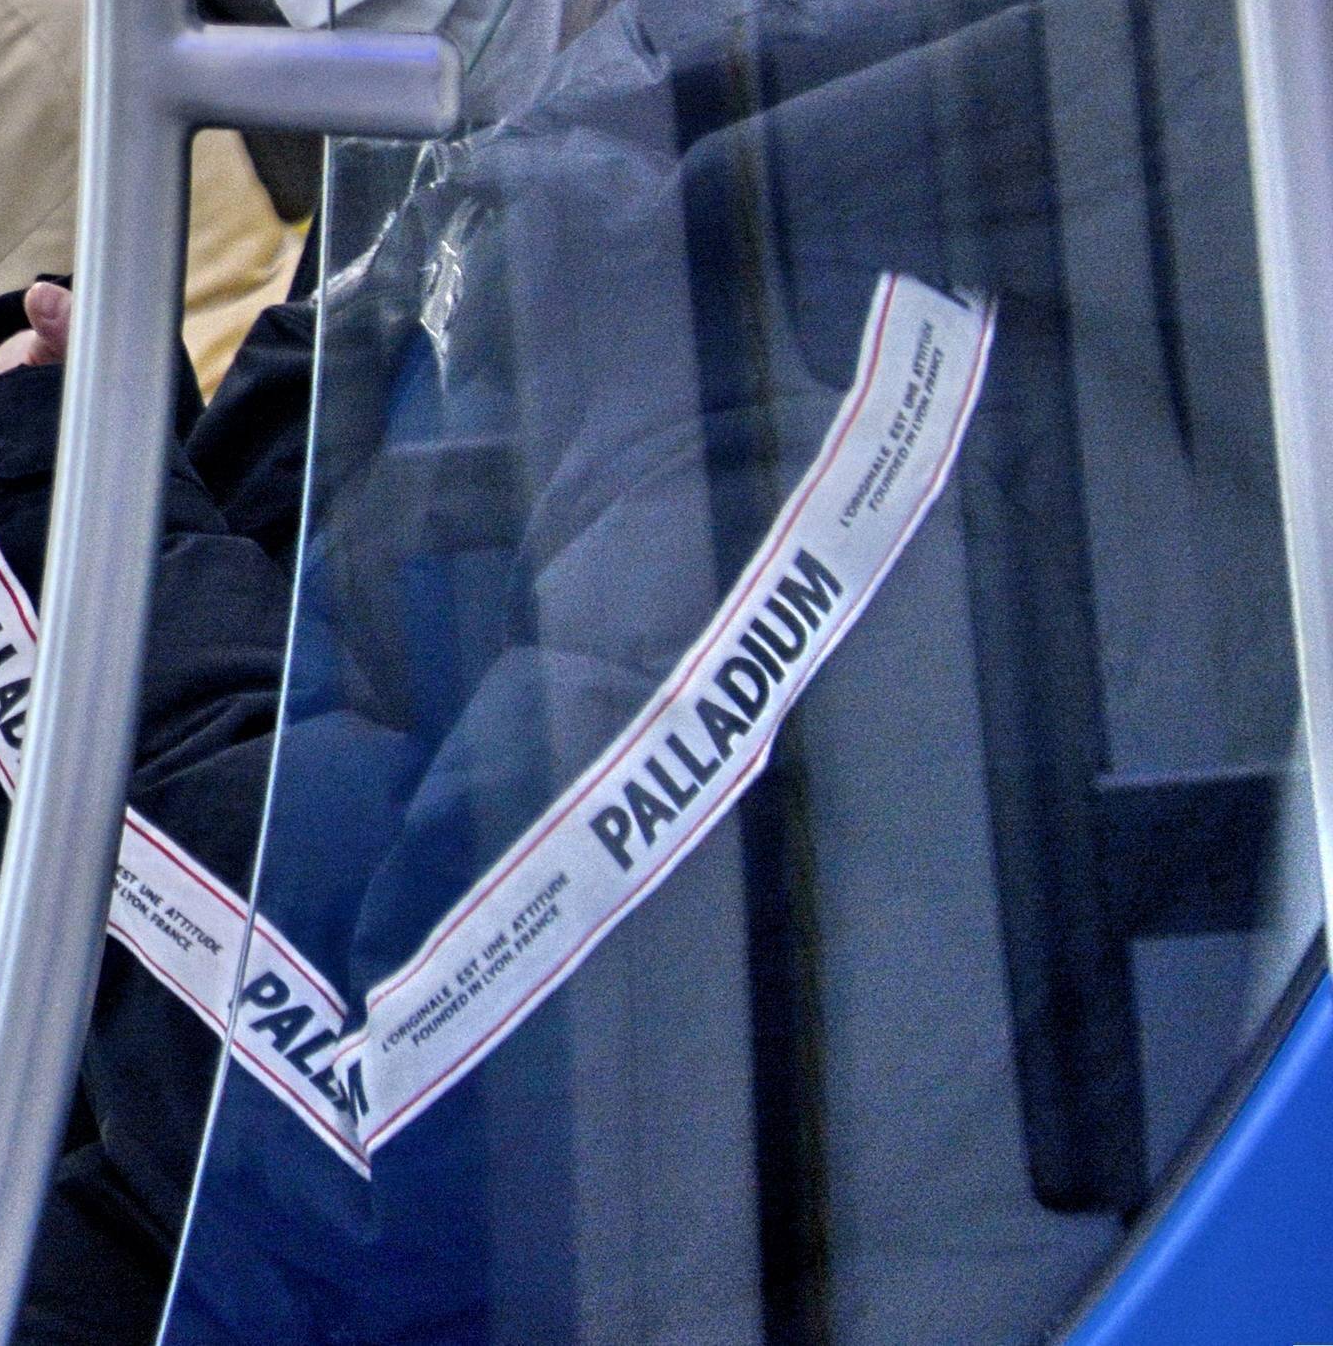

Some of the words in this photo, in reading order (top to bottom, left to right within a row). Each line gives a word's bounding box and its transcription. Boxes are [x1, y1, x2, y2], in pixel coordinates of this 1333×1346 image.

[890, 410, 909, 441] EST
[589, 548, 844, 872] PALLADIUM
[139, 884, 164, 907] UNE
[165, 907, 224, 955] ATTITUDE
[150, 913, 193, 952] FRANCE
[381, 984, 452, 1053] L'ORIGINALE
[456, 959, 480, 986] EST
[483, 931, 509, 960] UNE
[512, 871, 570, 933] ATTITUDE
[412, 993, 469, 1047] FOUNDED
[467, 980, 484, 998] IN
[513, 903, 560, 953] FRANCE
